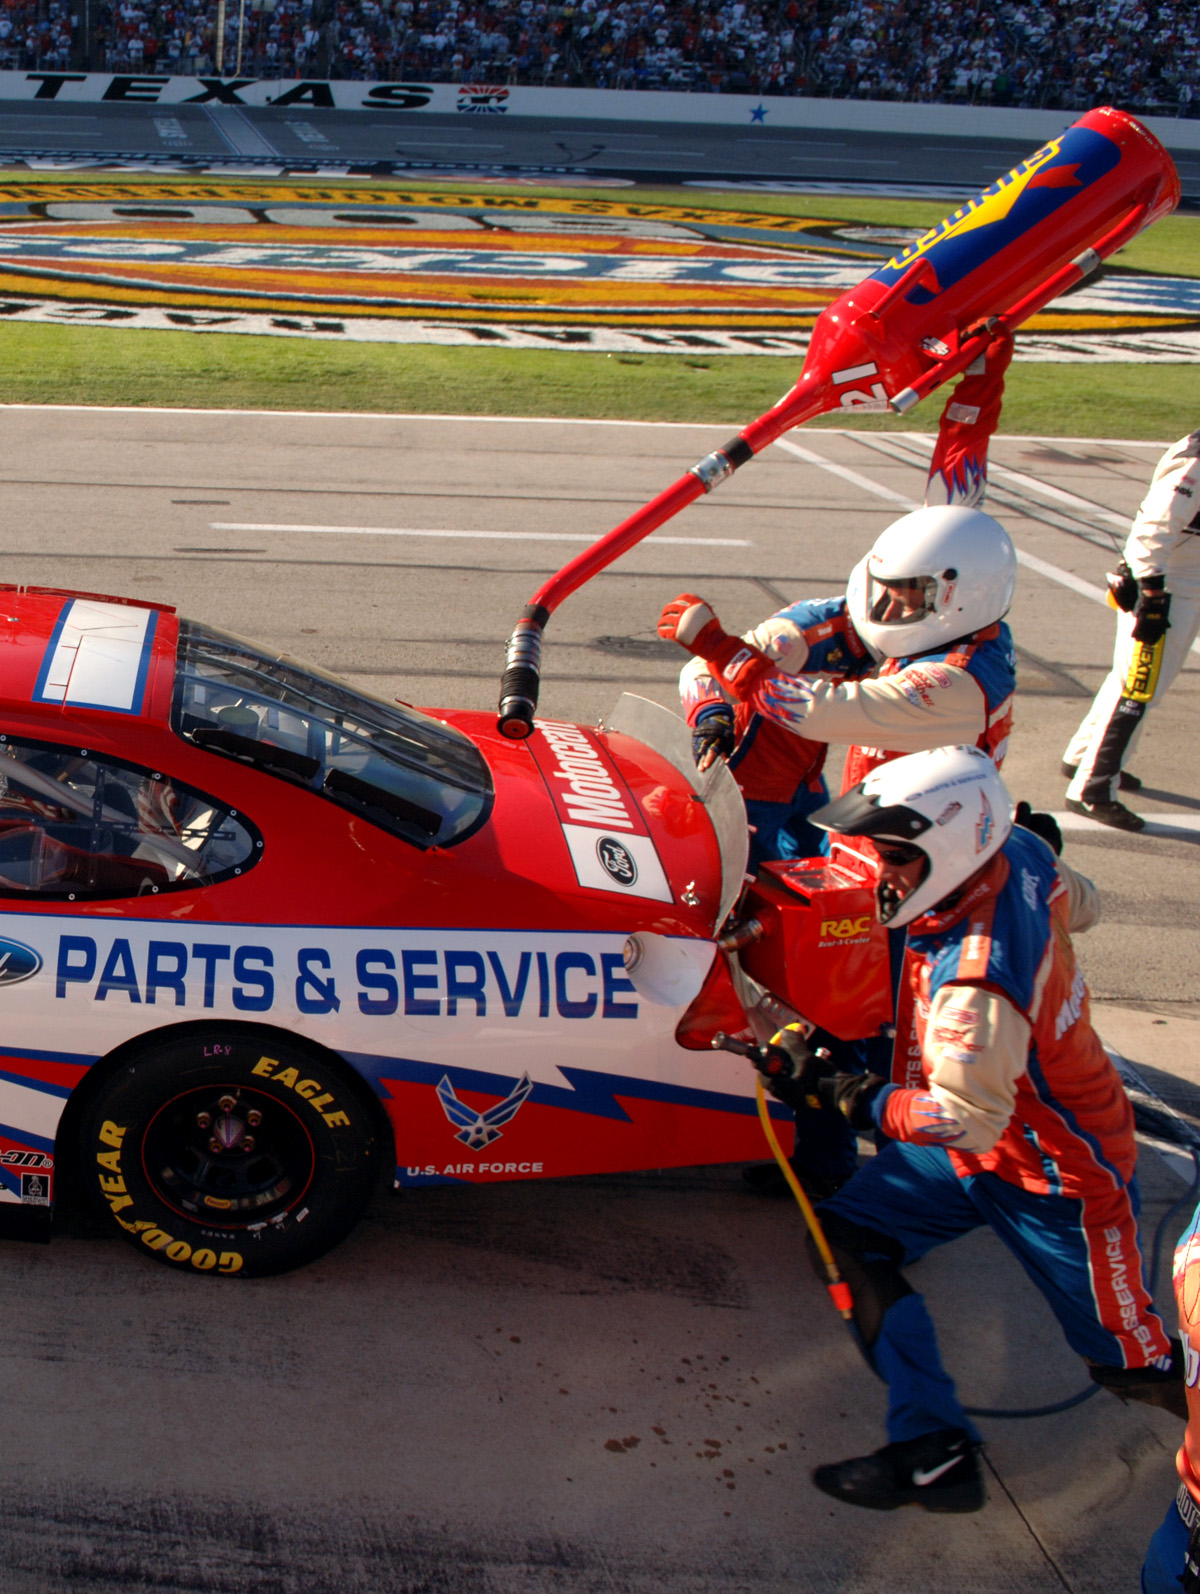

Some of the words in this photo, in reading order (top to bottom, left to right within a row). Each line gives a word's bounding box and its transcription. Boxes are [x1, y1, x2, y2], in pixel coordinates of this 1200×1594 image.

[26, 74, 434, 109] TEXAS
[294, 190, 541, 209] MOTOR
[569, 201, 803, 230] TEXAS
[38, 201, 708, 239] 500
[601, 842, 633, 877] Ford
[820, 916, 871, 938] RAC
[55, 934, 275, 1013] PARTS
[295, 947, 342, 1015] &
[356, 948, 640, 1019] SERVICE
[251, 1056, 351, 1128] EAGLE
[406, 1165, 439, 1177] U.S.
[442, 1163, 474, 1175] AIR
[477, 1162, 545, 1174] FORCE
[1104, 1225, 1135, 1315] SERVICE
